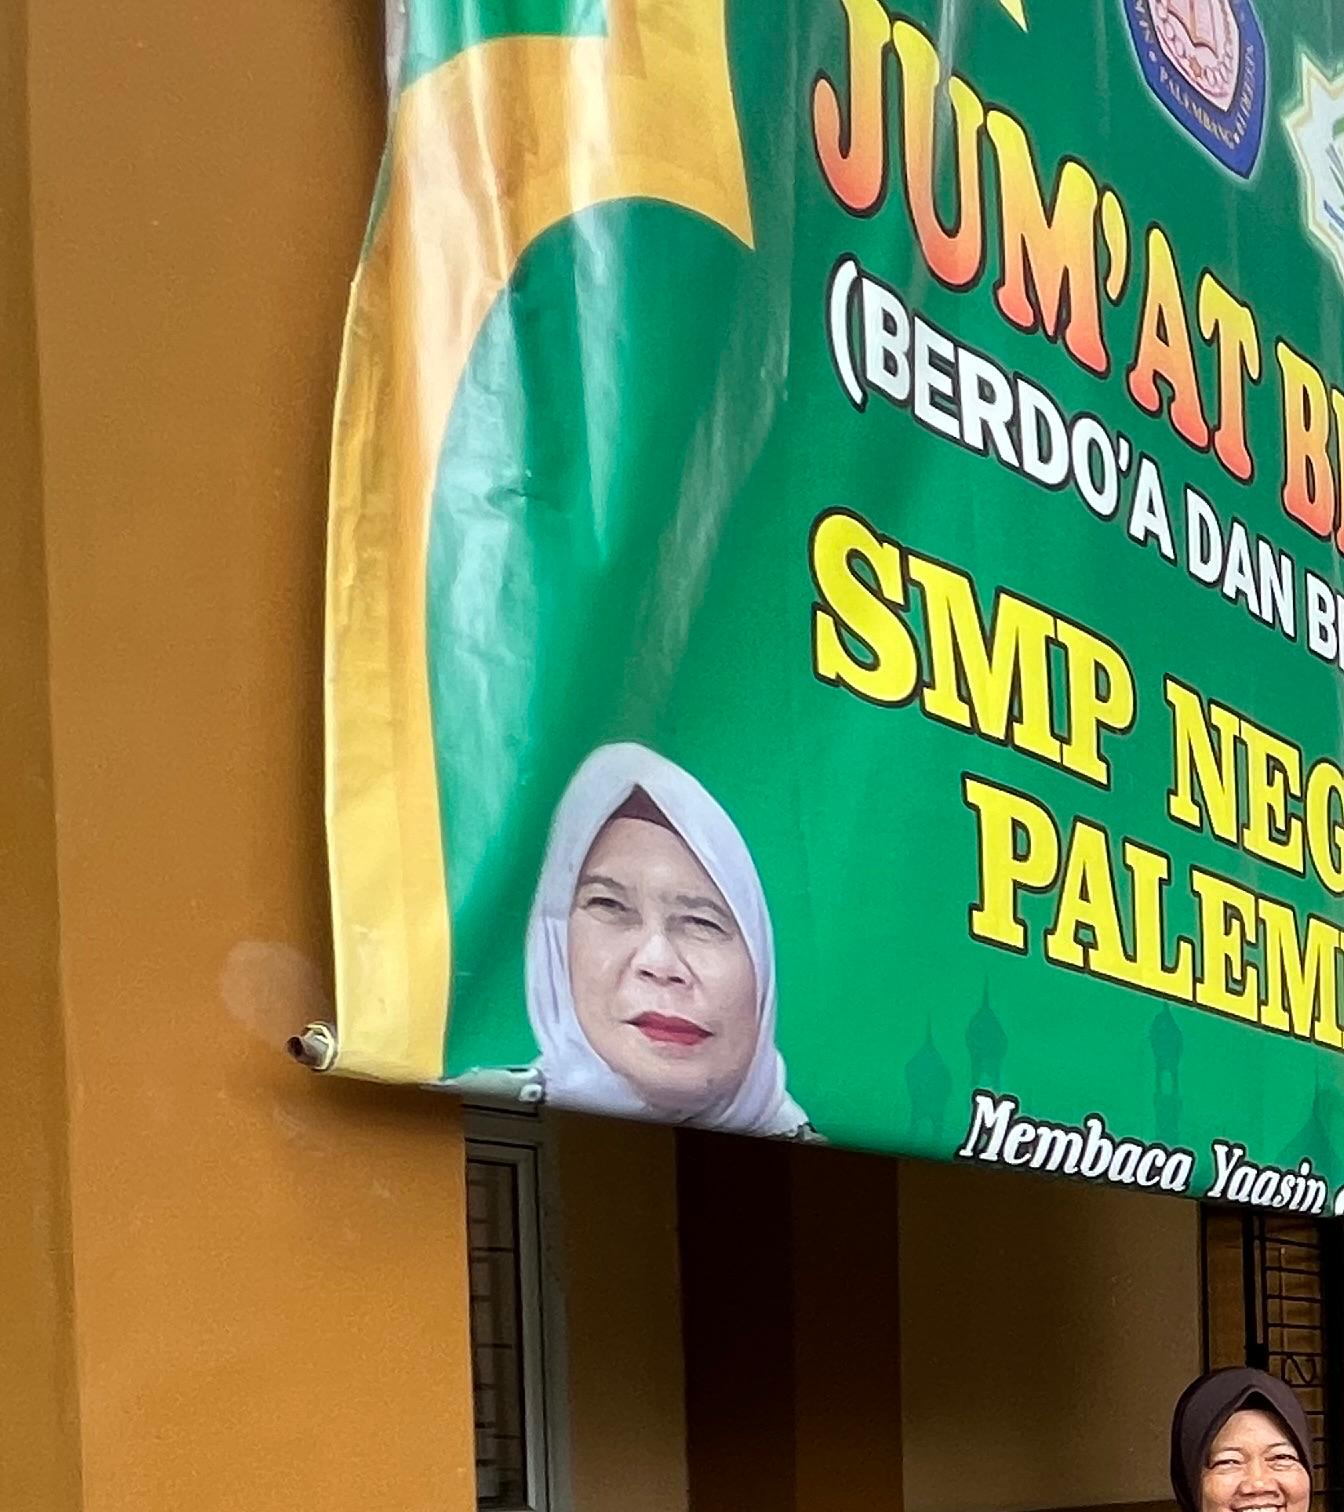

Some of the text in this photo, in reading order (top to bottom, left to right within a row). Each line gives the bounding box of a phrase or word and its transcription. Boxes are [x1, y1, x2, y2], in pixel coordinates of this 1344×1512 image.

[812, 0, 1261, 484] JUM'AT
[827, 256, 1177, 562] (BERDO'A
[1183, 483, 1297, 640] DAN
[813, 511, 1134, 783] SMP
[958, 1092, 1195, 1193] Membaca
[1206, 1143, 1328, 1215] Yaasin
